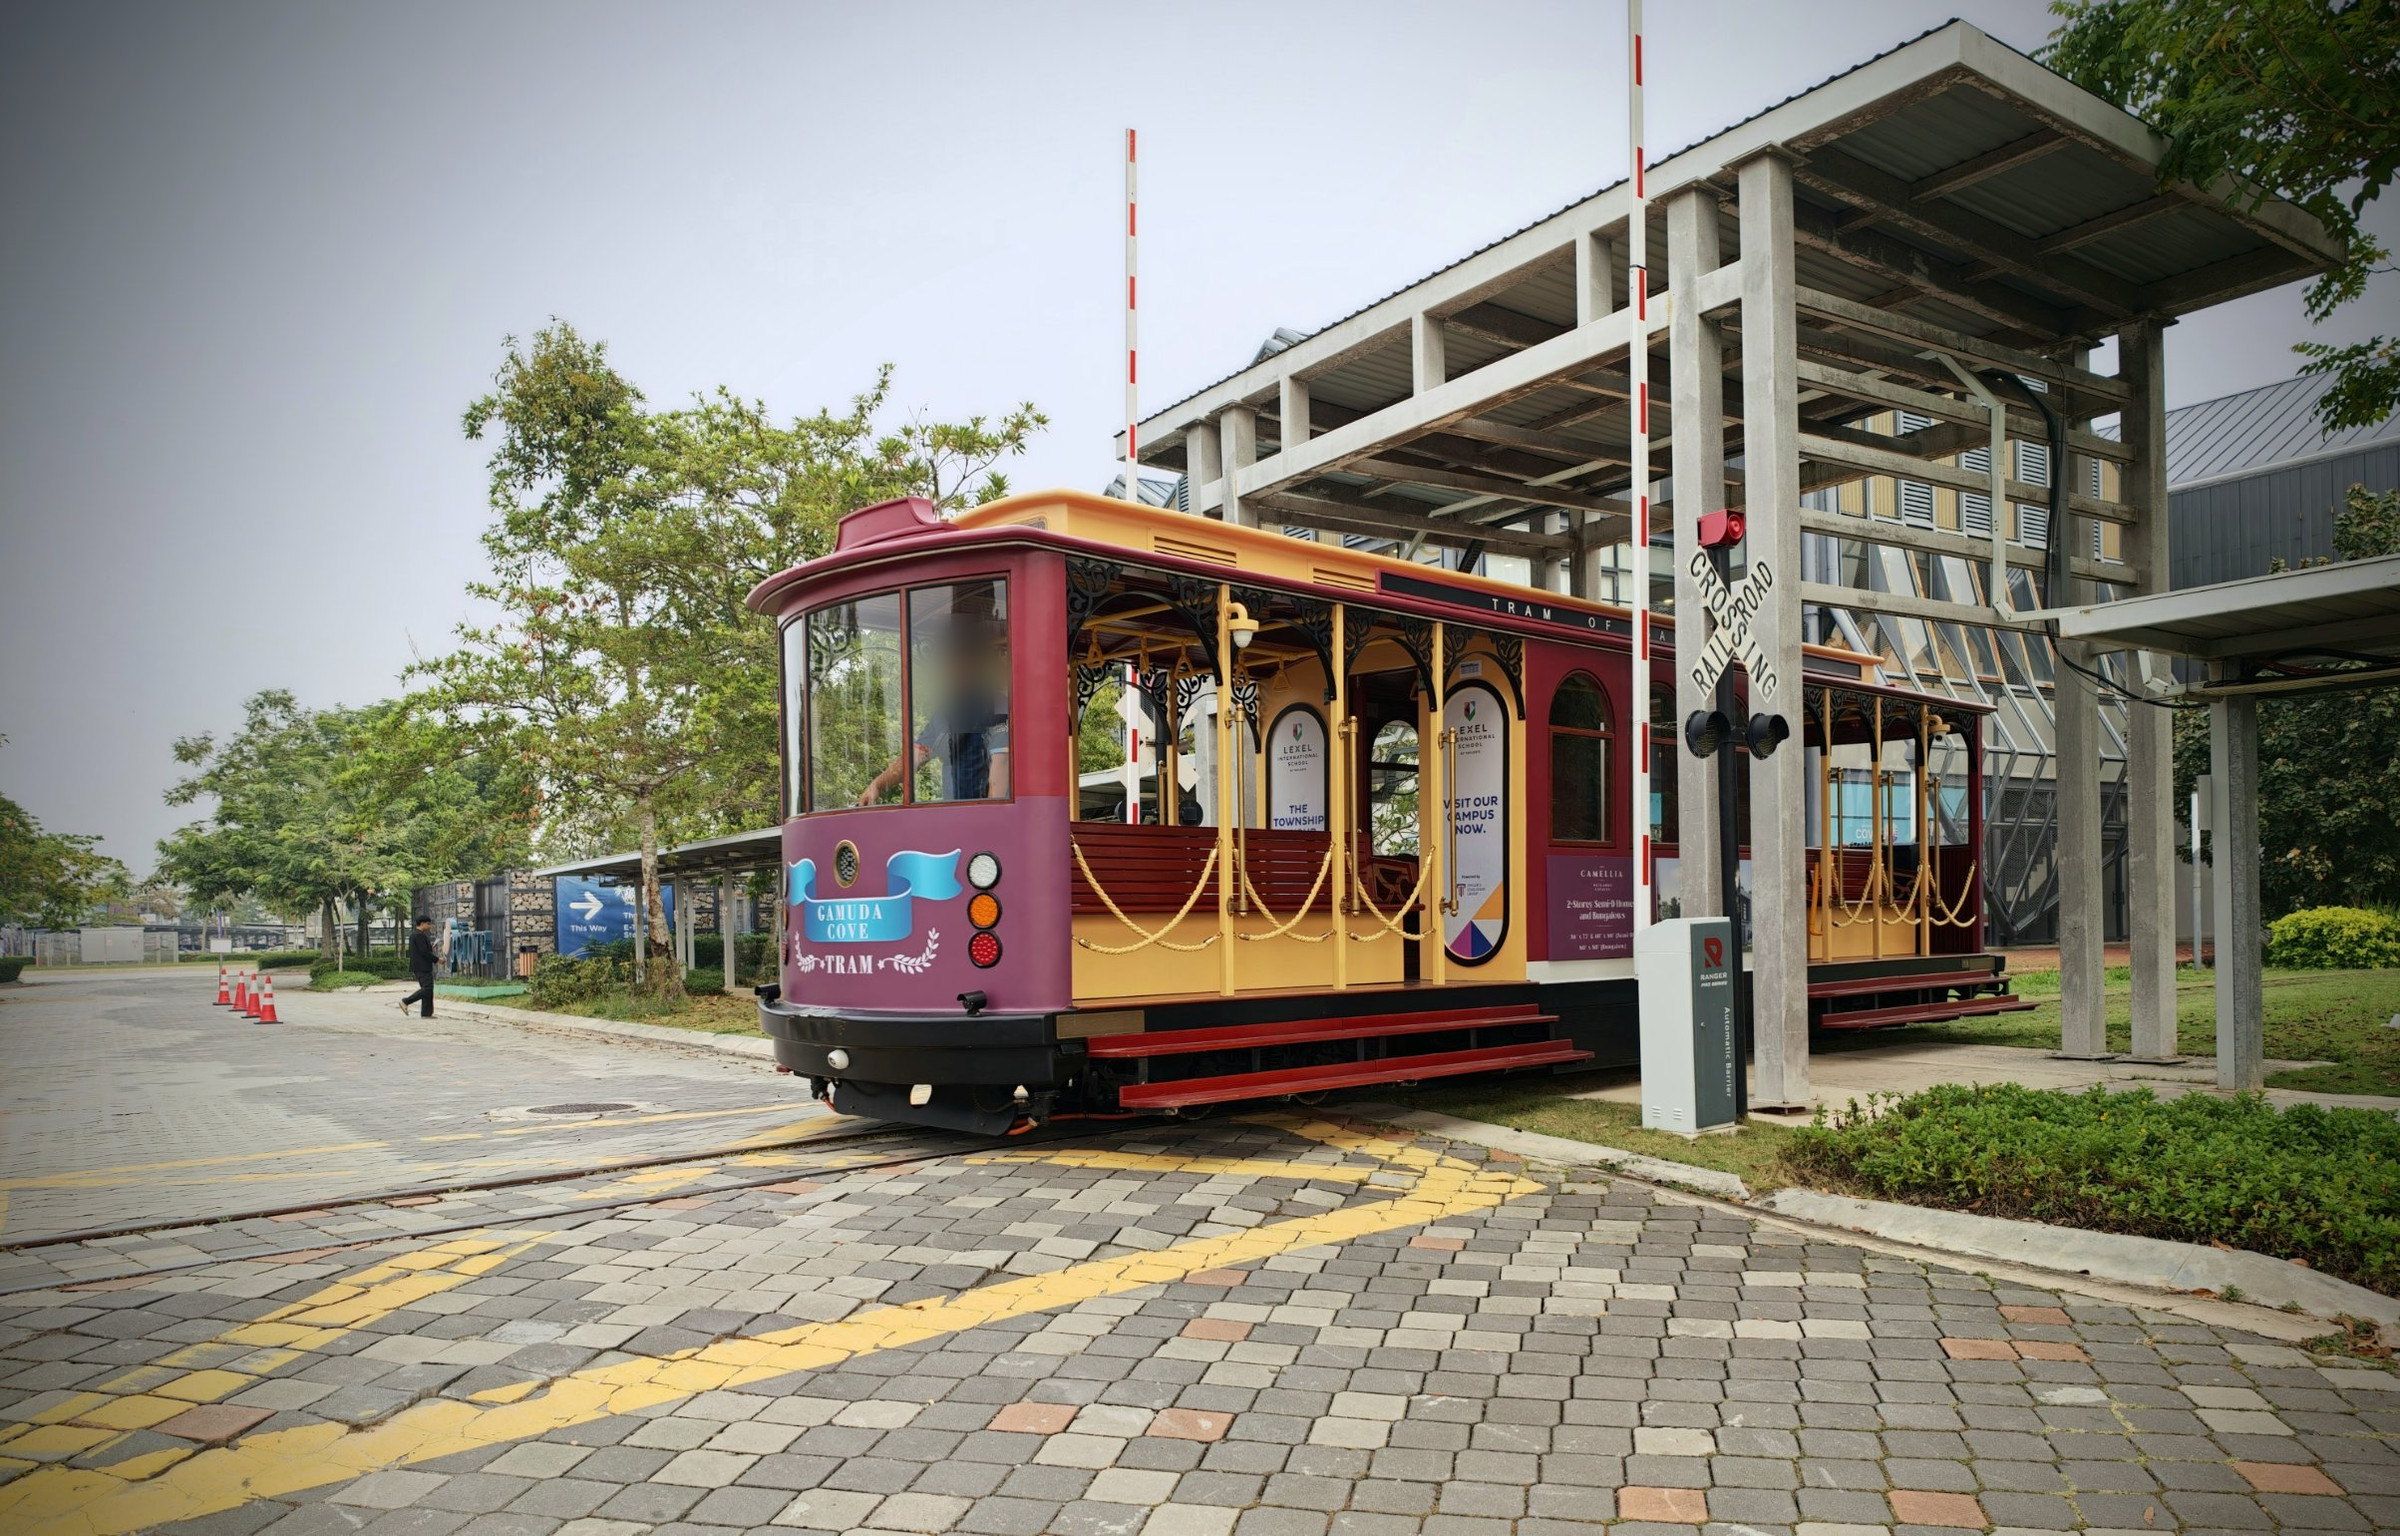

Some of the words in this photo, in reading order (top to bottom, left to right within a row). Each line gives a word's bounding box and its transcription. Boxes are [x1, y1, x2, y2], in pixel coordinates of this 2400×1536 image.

[1492, 599, 1551, 620] TRAM
[1588, 617, 1611, 633] OF
[1459, 724, 1488, 735] EXEL
[1283, 744, 1312, 754] LEXEL
[1277, 753, 1319, 761] INTERNATIONAL
[1443, 798, 1472, 809] VSIT
[1473, 796, 1498, 807] OUR
[1289, 804, 1308, 815] THE
[1273, 815, 1325, 828] TOWNSHIP
[1455, 824, 1487, 835] NOW.
[1580, 870, 1623, 878] CAMELLIA
[817, 903, 883, 922] GAMUDA
[590, 925, 607, 933] Way
[826, 923, 870, 940] COVE
[825, 954, 874, 975] TRAM
[1700, 972, 1728, 981] RANGER
